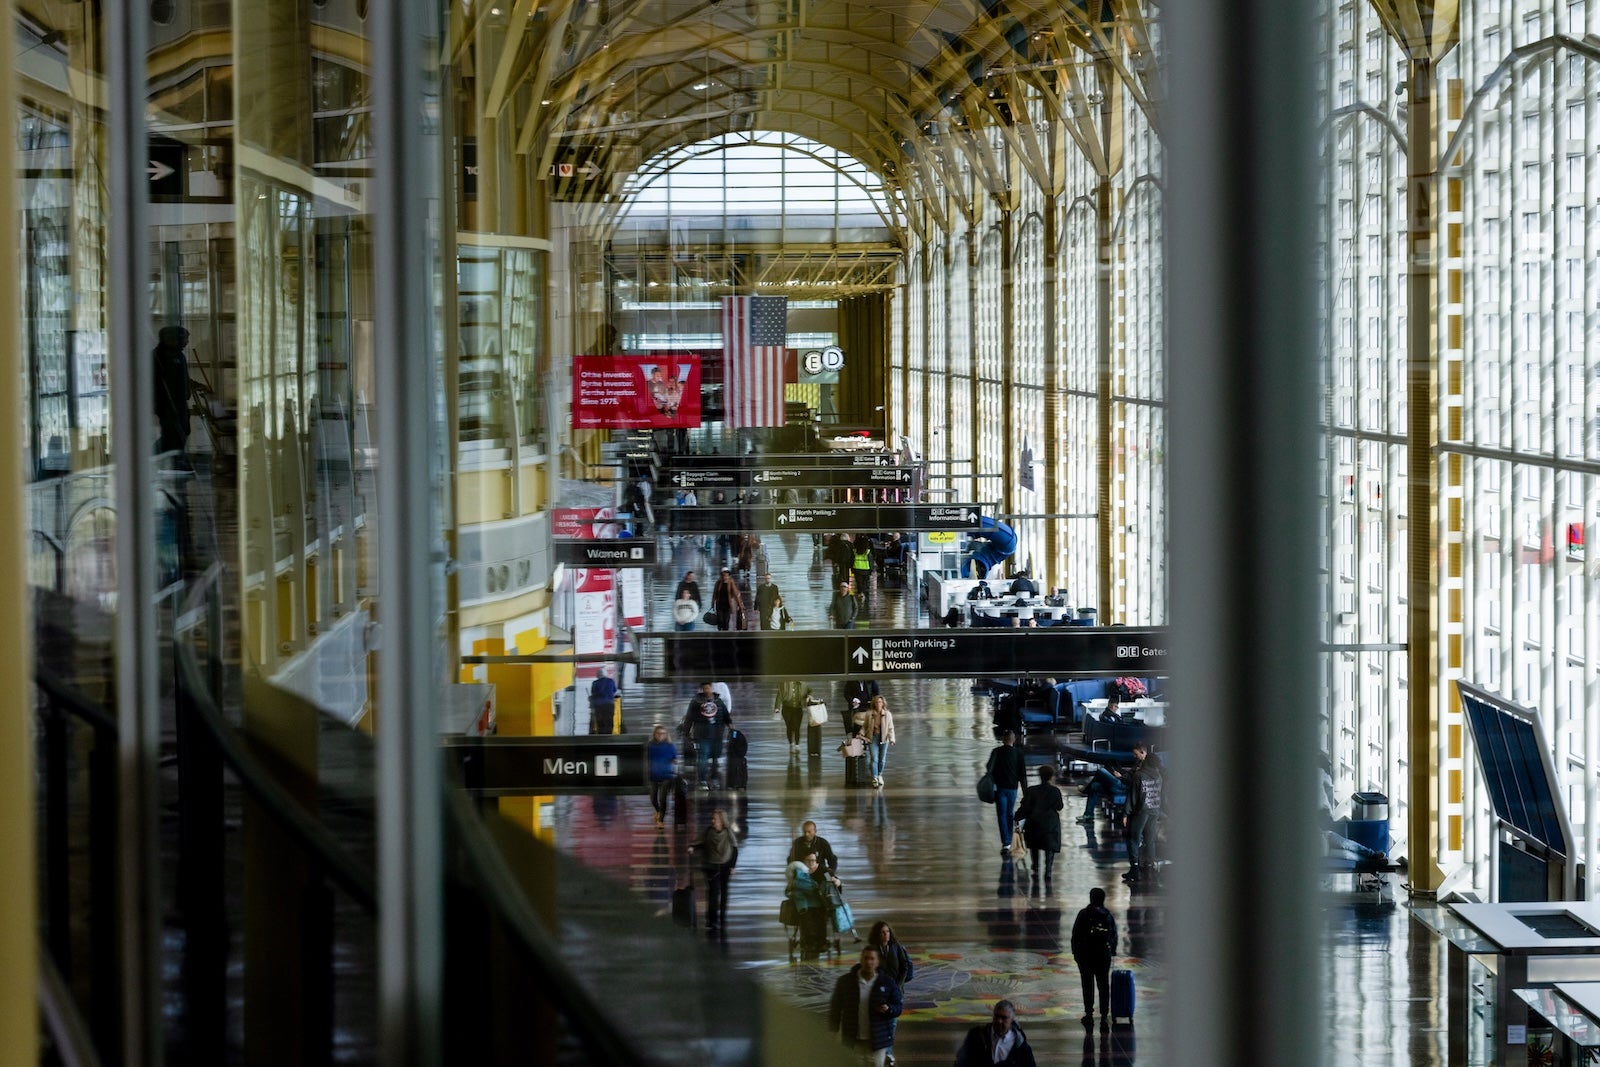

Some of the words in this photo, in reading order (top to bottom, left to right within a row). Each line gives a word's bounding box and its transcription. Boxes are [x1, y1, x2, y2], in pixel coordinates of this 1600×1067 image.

[828, 352, 839, 366] D
[587, 549, 627, 559] Women
[885, 639, 911, 648] North
[914, 640, 948, 649] Parking
[949, 639, 956, 648] 2
[885, 650, 913, 659] Metro
[885, 661, 921, 670] Women
[543, 758, 588, 775] Men
